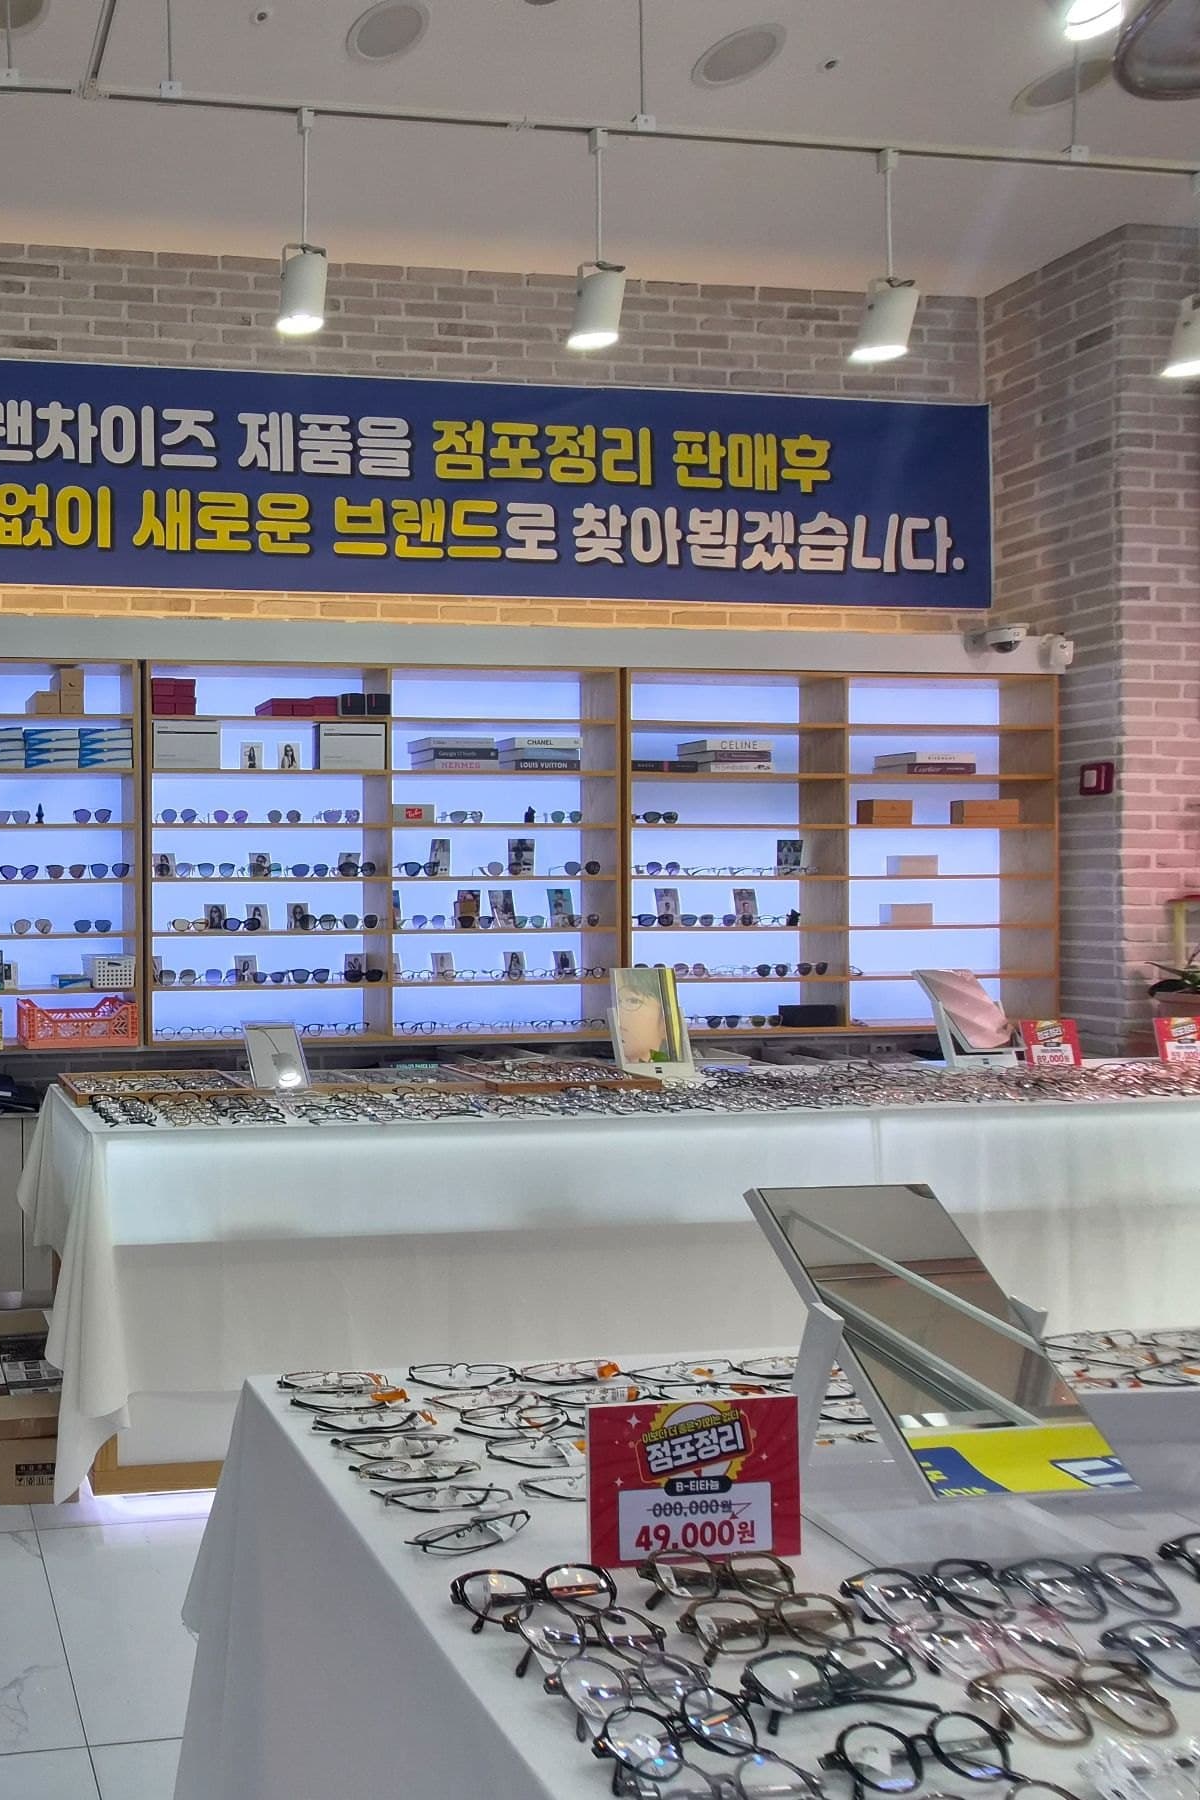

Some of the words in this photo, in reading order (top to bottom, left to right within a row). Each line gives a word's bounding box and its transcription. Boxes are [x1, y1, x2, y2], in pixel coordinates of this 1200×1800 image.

[237, 411, 411, 478] 제품을
[432, 420, 652, 487] 점포정리
[672, 430, 832, 493] 판매후
[133, 488, 311, 555] 새로운
[334, 496, 558, 562] 브랜드로
[572, 502, 965, 574] 찾아뵙겠습니다.
[520, 761, 539, 769] LOUIS
[540, 761, 568, 769] VUITTON
[721, 740, 759, 750] CELINE
[646, 1421, 745, 1473] 점포정리
